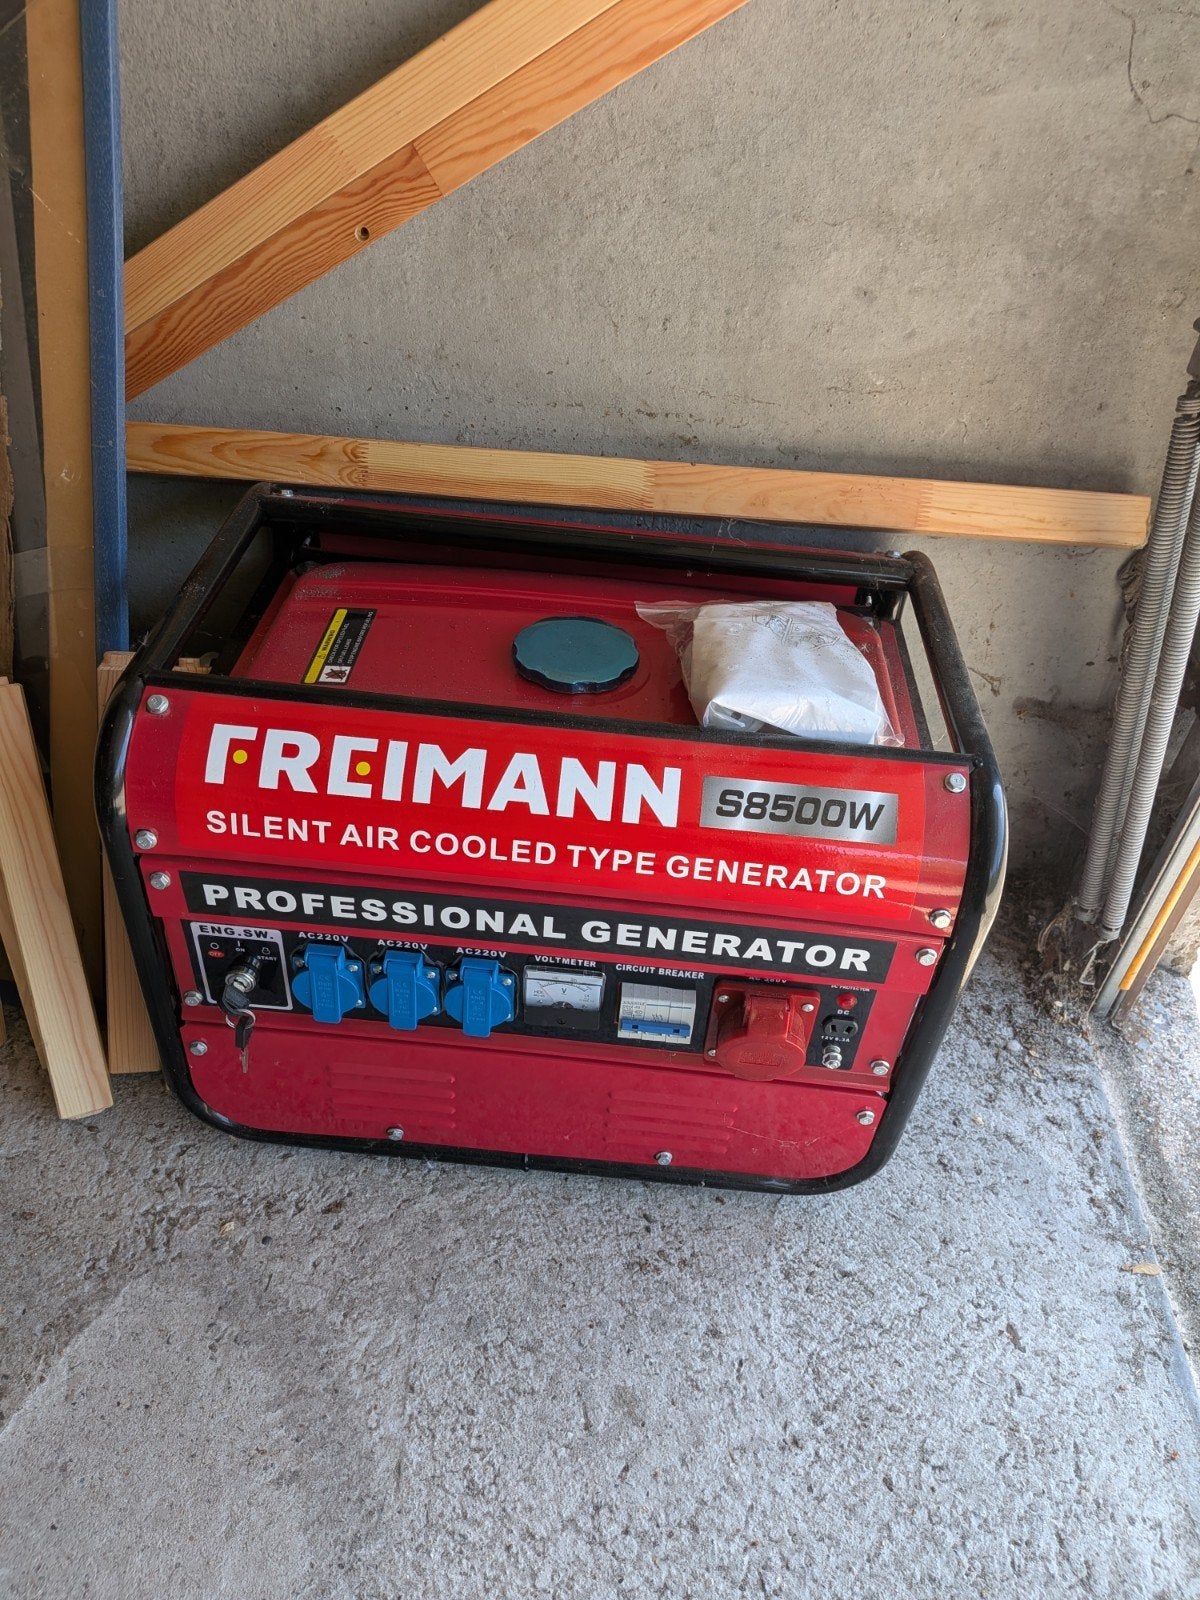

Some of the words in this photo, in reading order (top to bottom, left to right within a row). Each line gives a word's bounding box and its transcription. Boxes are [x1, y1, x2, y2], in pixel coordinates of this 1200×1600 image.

[204, 723, 682, 828] FREIMANN
[715, 789, 885, 831] S8500W
[206, 810, 332, 844] SILENT
[340, 824, 400, 850] AIR
[409, 830, 557, 866] COOLED
[566, 845, 655, 875] TYPE
[666, 855, 887, 899] GENERATOR
[199, 925, 274, 939] ENG.SW.
[202, 883, 567, 939] PROFESSIONAL
[581, 920, 870, 972] GENERATOR
[298, 931, 349, 943] AC220V
[377, 939, 428, 950] AC220V
[456, 947, 507, 958] AC220V
[534, 955, 597, 968] VOLTMETER
[615, 963, 656, 974] CIRCUIT
[658, 968, 705, 980] BREAKER
